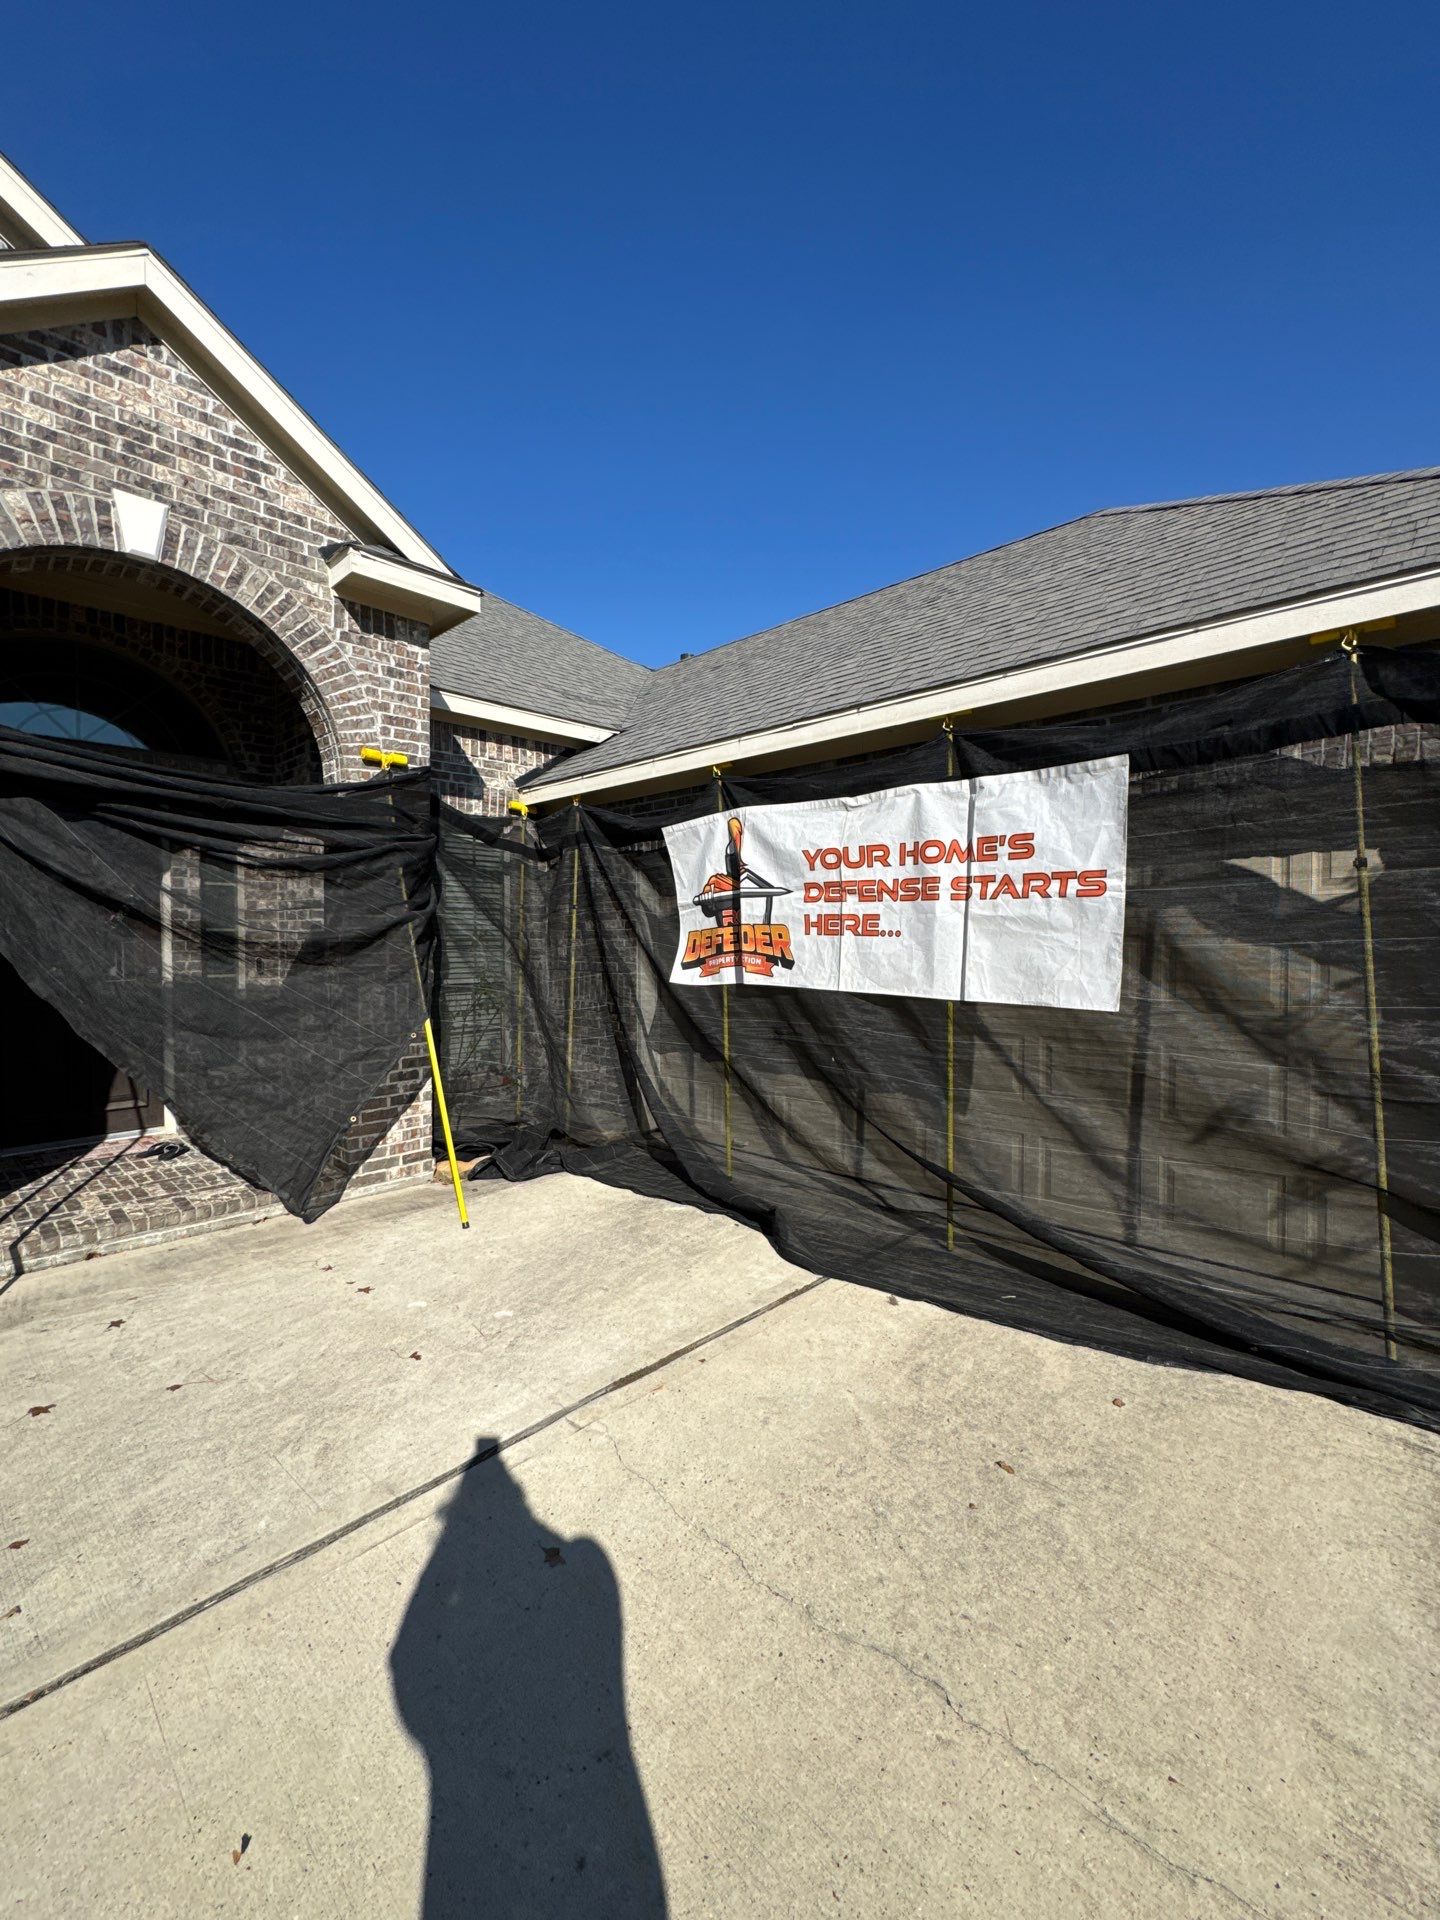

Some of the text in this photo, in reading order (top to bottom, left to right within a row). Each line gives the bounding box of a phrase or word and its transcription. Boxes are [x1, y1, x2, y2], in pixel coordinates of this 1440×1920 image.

[802, 832, 1035, 871] YOUR HOME'S
[803, 869, 1108, 903] DEFENSE STARTS
[804, 913, 901, 938] HERE...
[682, 923, 795, 967] DEFEDER
